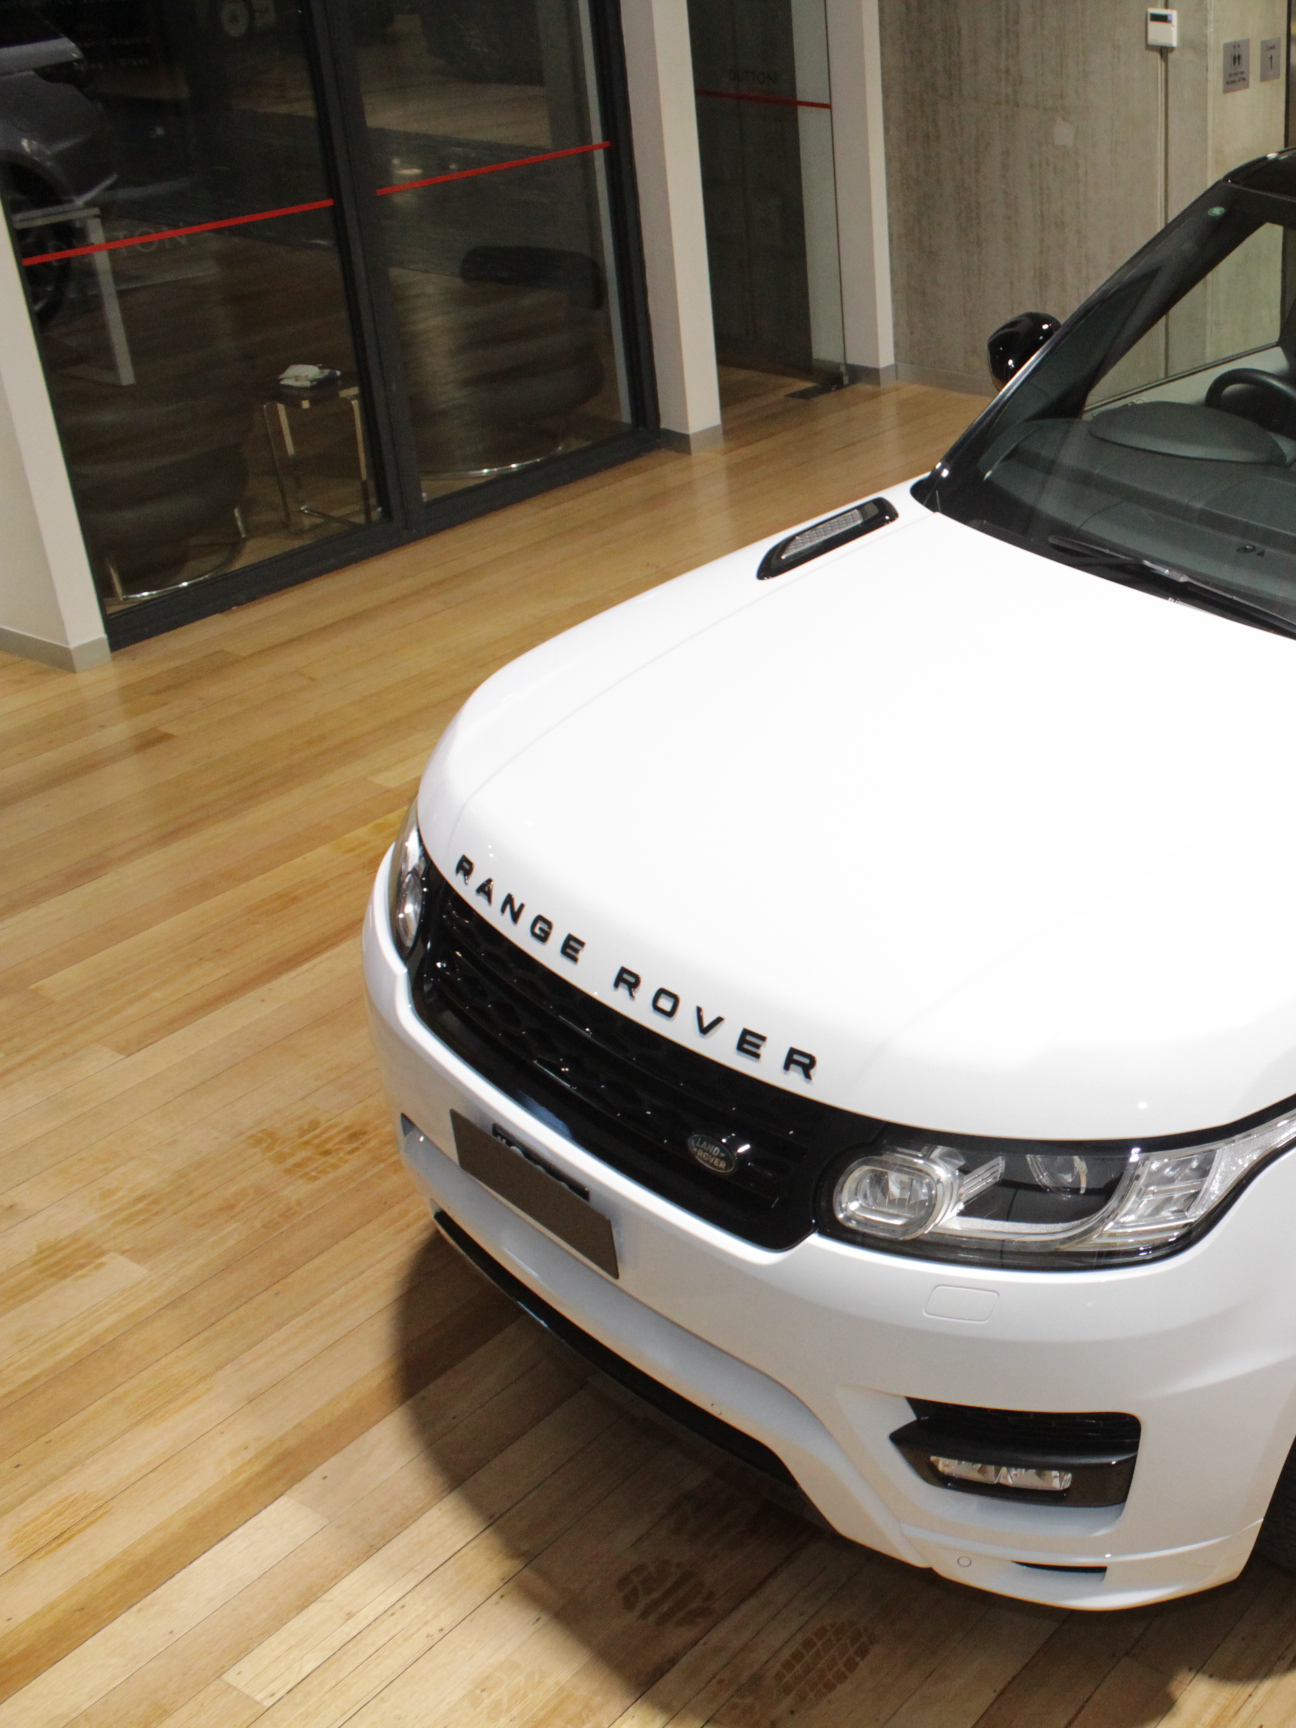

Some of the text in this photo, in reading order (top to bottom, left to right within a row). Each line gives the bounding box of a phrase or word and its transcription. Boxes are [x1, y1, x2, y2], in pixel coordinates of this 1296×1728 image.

[454, 853, 819, 1082] RANGE ROVER
[696, 1138, 721, 1157] LAND
[697, 1149, 727, 1170] ROVER
